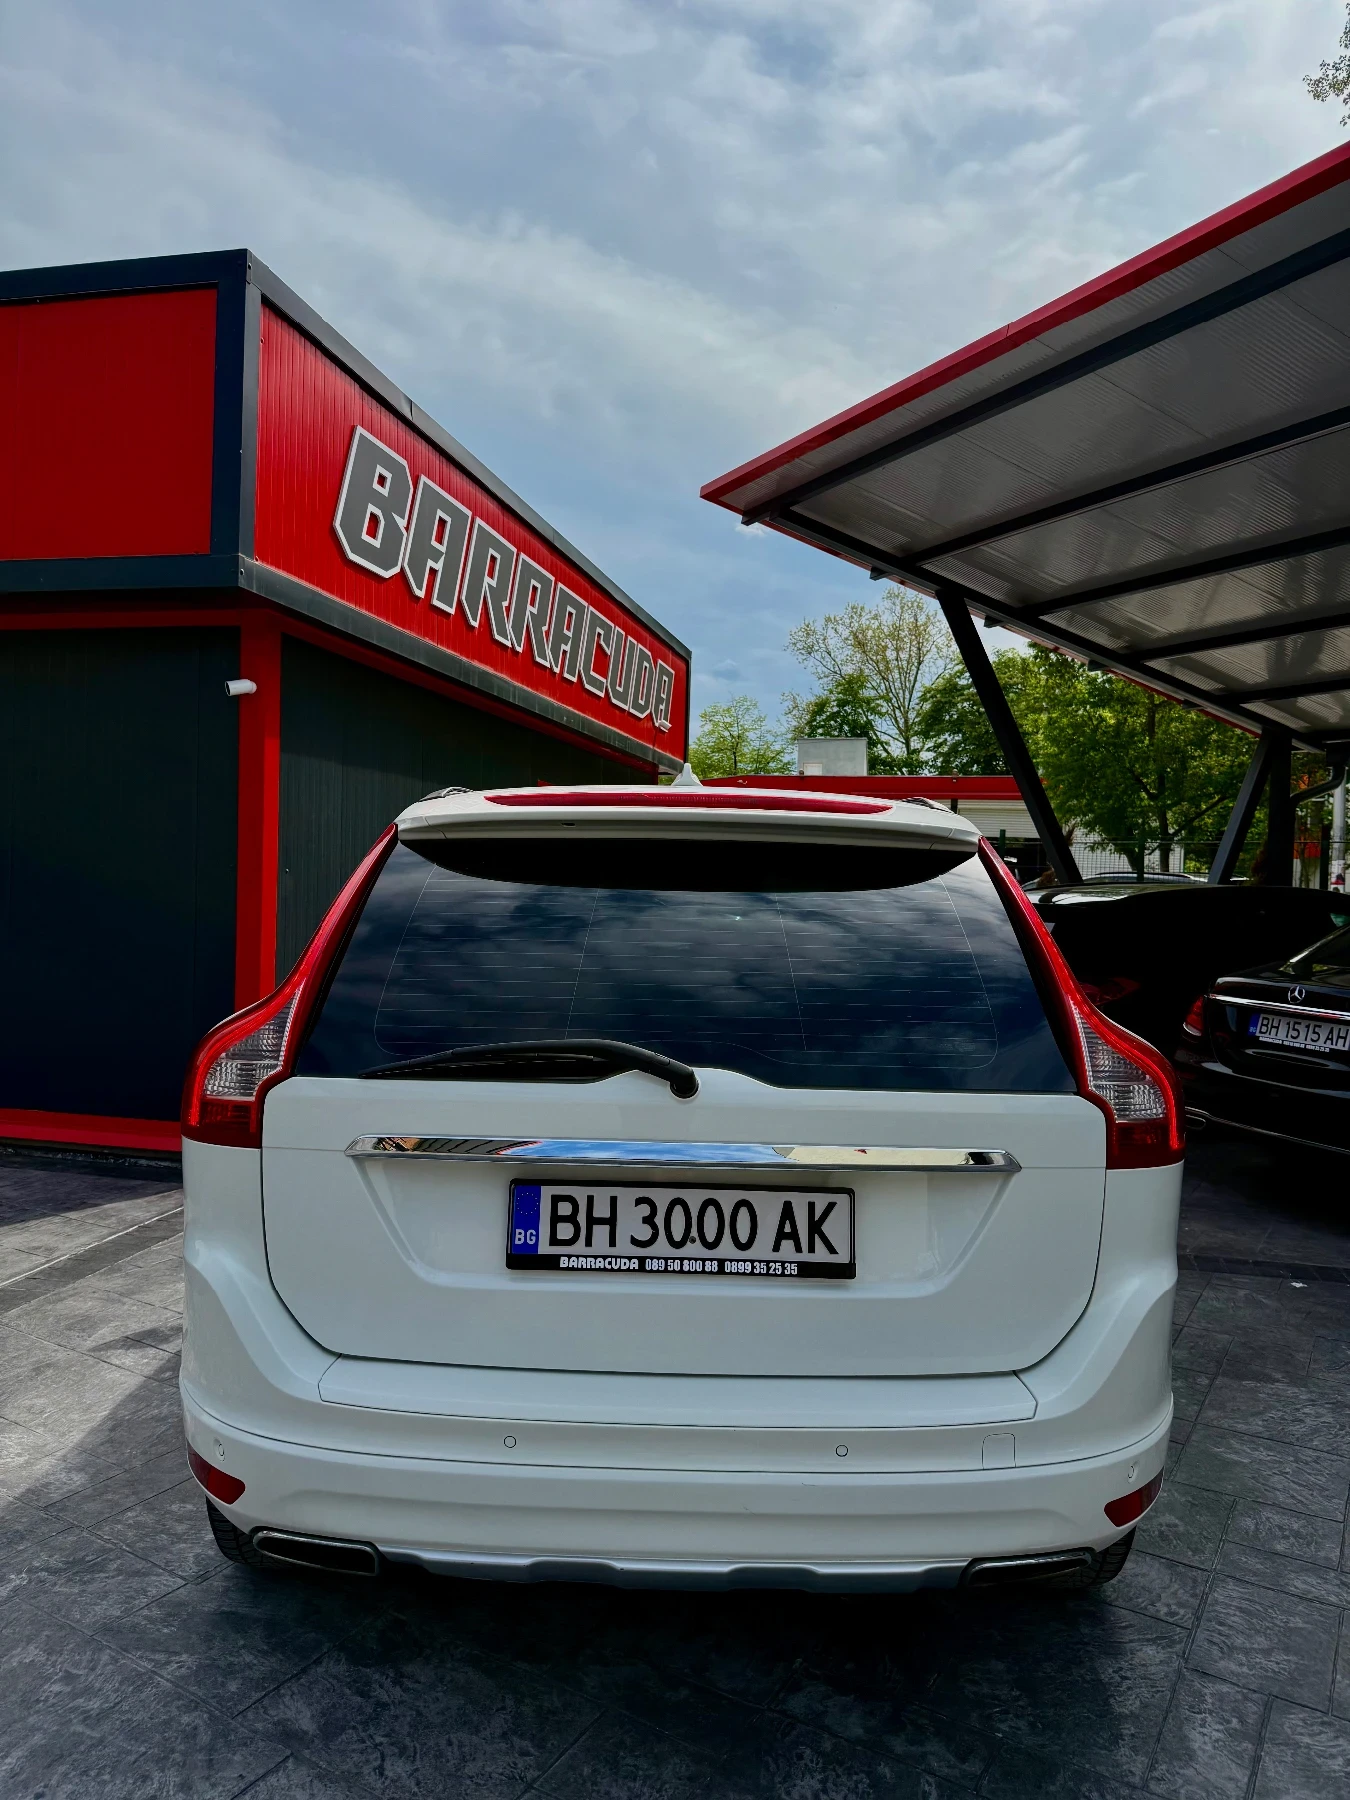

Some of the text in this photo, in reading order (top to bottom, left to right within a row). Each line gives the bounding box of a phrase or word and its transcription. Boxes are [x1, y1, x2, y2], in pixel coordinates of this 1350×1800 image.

[333, 424, 675, 732] BARRACUDA
[1259, 1017, 1281, 1036] BH
[1285, 1021, 1322, 1042] 1515
[1323, 1026, 1349, 1047] AH
[515, 1228, 536, 1245] BG
[548, 1194, 839, 1255] BH 3000 AK
[559, 1256, 798, 1275] BARRACUDA 089 50 800 88 0899 35 25 35
